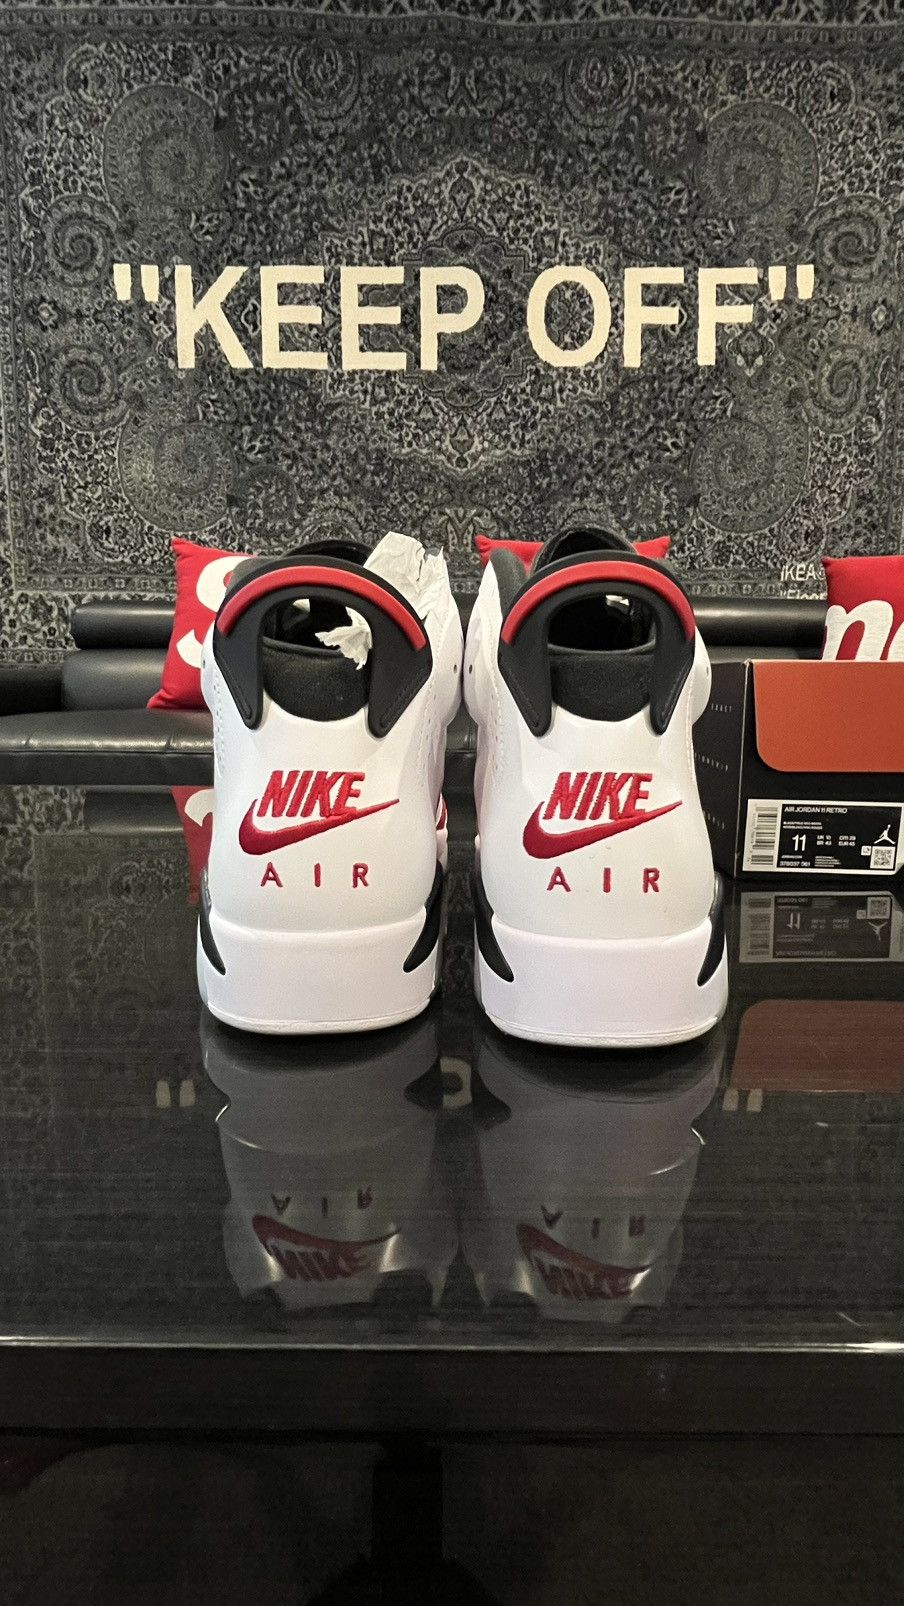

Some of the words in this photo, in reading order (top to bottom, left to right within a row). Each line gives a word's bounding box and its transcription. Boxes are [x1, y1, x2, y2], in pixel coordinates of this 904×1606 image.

[113, 263, 485, 371] "KEEP
[526, 264, 815, 368] OFF"
[256, 770, 365, 817] NIKE
[543, 771, 653, 820] NIKE
[791, 834, 807, 852] 11
[260, 861, 370, 889] AIR
[546, 866, 660, 893] AIR
